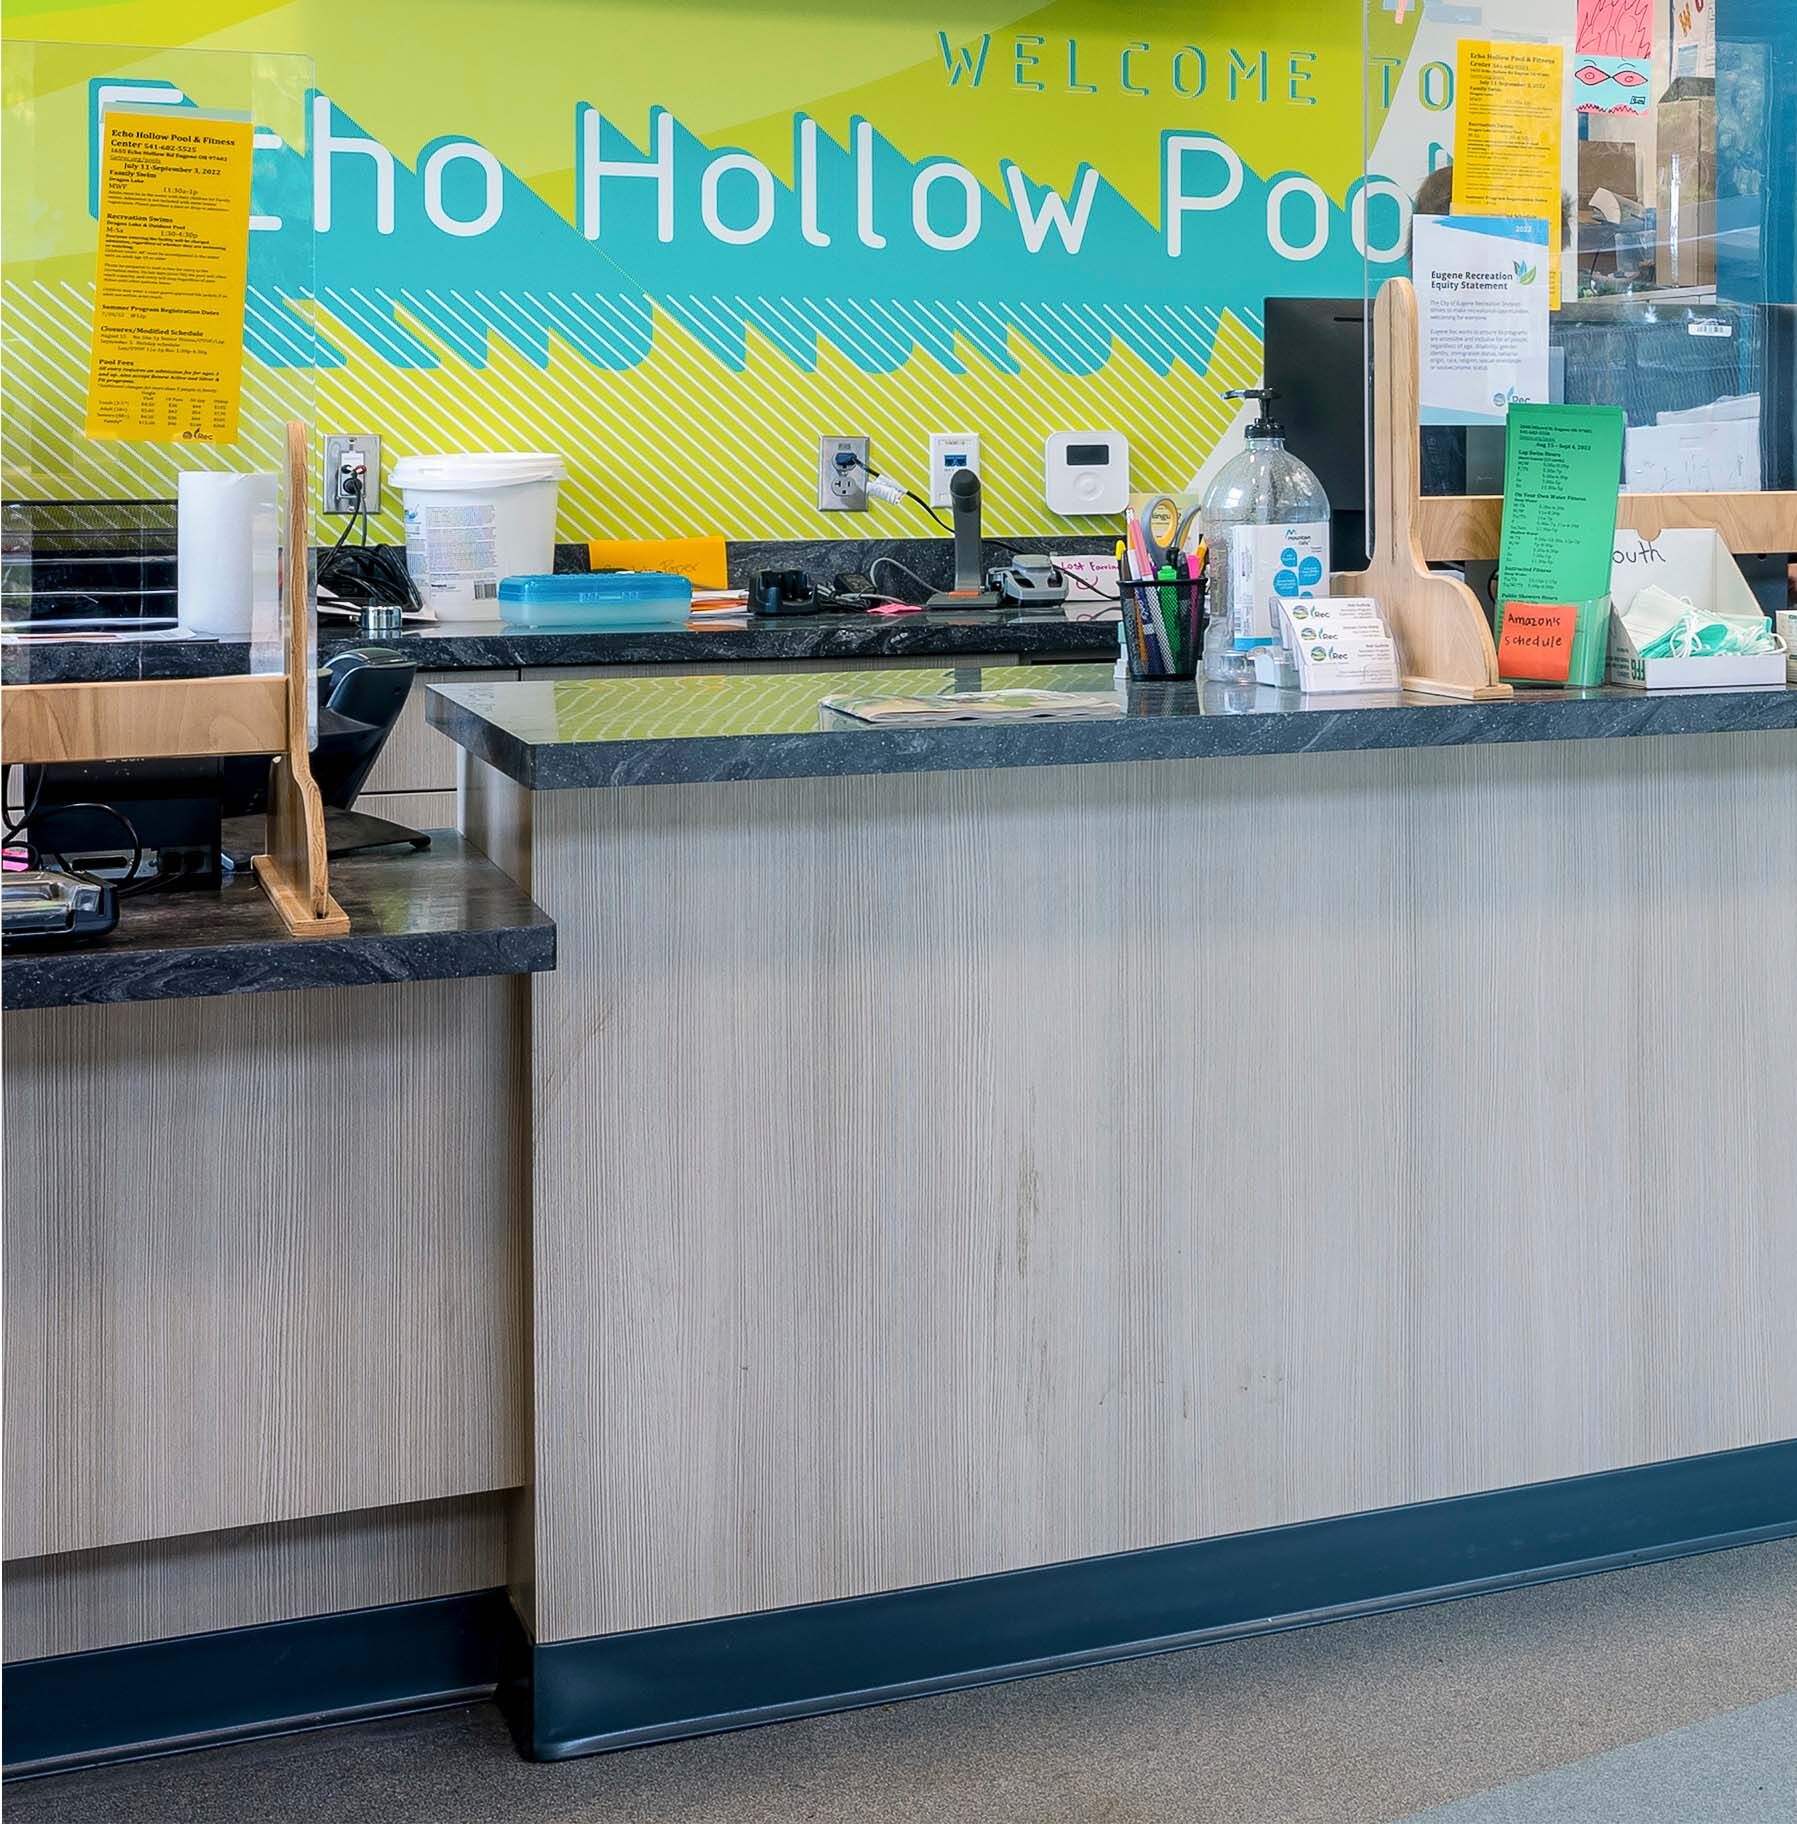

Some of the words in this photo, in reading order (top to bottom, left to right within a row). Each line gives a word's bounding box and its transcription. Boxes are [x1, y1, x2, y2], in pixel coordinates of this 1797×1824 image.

[936, 29, 1318, 107] WELCOME
[1367, 56, 1454, 112] TO
[111, 129, 134, 139] Echo
[135, 131, 168, 141] Hollow
[171, 134, 192, 143] Pool
[193, 135, 201, 143] &
[202, 136, 235, 147] Fitness
[110, 140, 142, 149] Center
[98, 86, 503, 236] ho
[585, 108, 1098, 255] Hollow
[1168, 136, 1447, 263] Poo
[1431, 270, 1463, 281] Eugene
[1465, 271, 1513, 280] Recreation
[1431, 281, 1459, 291] Equity
[1460, 281, 1508, 290] Statement
[198, 432, 213, 440] Rec
[1612, 540, 1666, 564] outh
[1508, 613, 1561, 627] Amazon's
[1332, 652, 1348, 660] Rec
